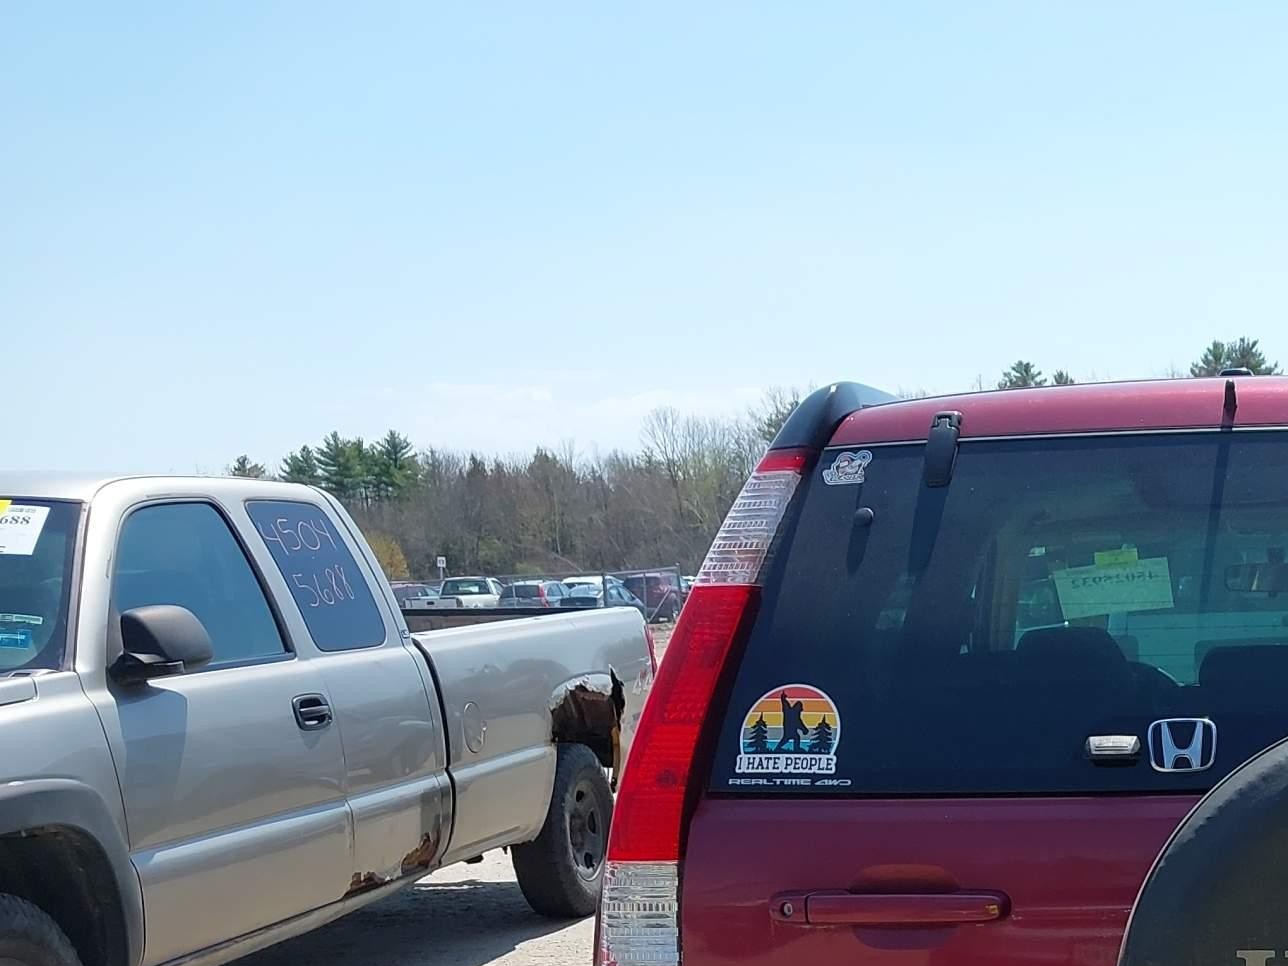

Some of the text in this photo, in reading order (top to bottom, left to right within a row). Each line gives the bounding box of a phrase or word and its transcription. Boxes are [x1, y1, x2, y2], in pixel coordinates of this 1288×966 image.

[262, 518, 339, 556] 4504
[292, 564, 355, 608] 5688
[738, 757, 834, 771] I HATE PEOPLE
[728, 778, 811, 786] REALTIME
